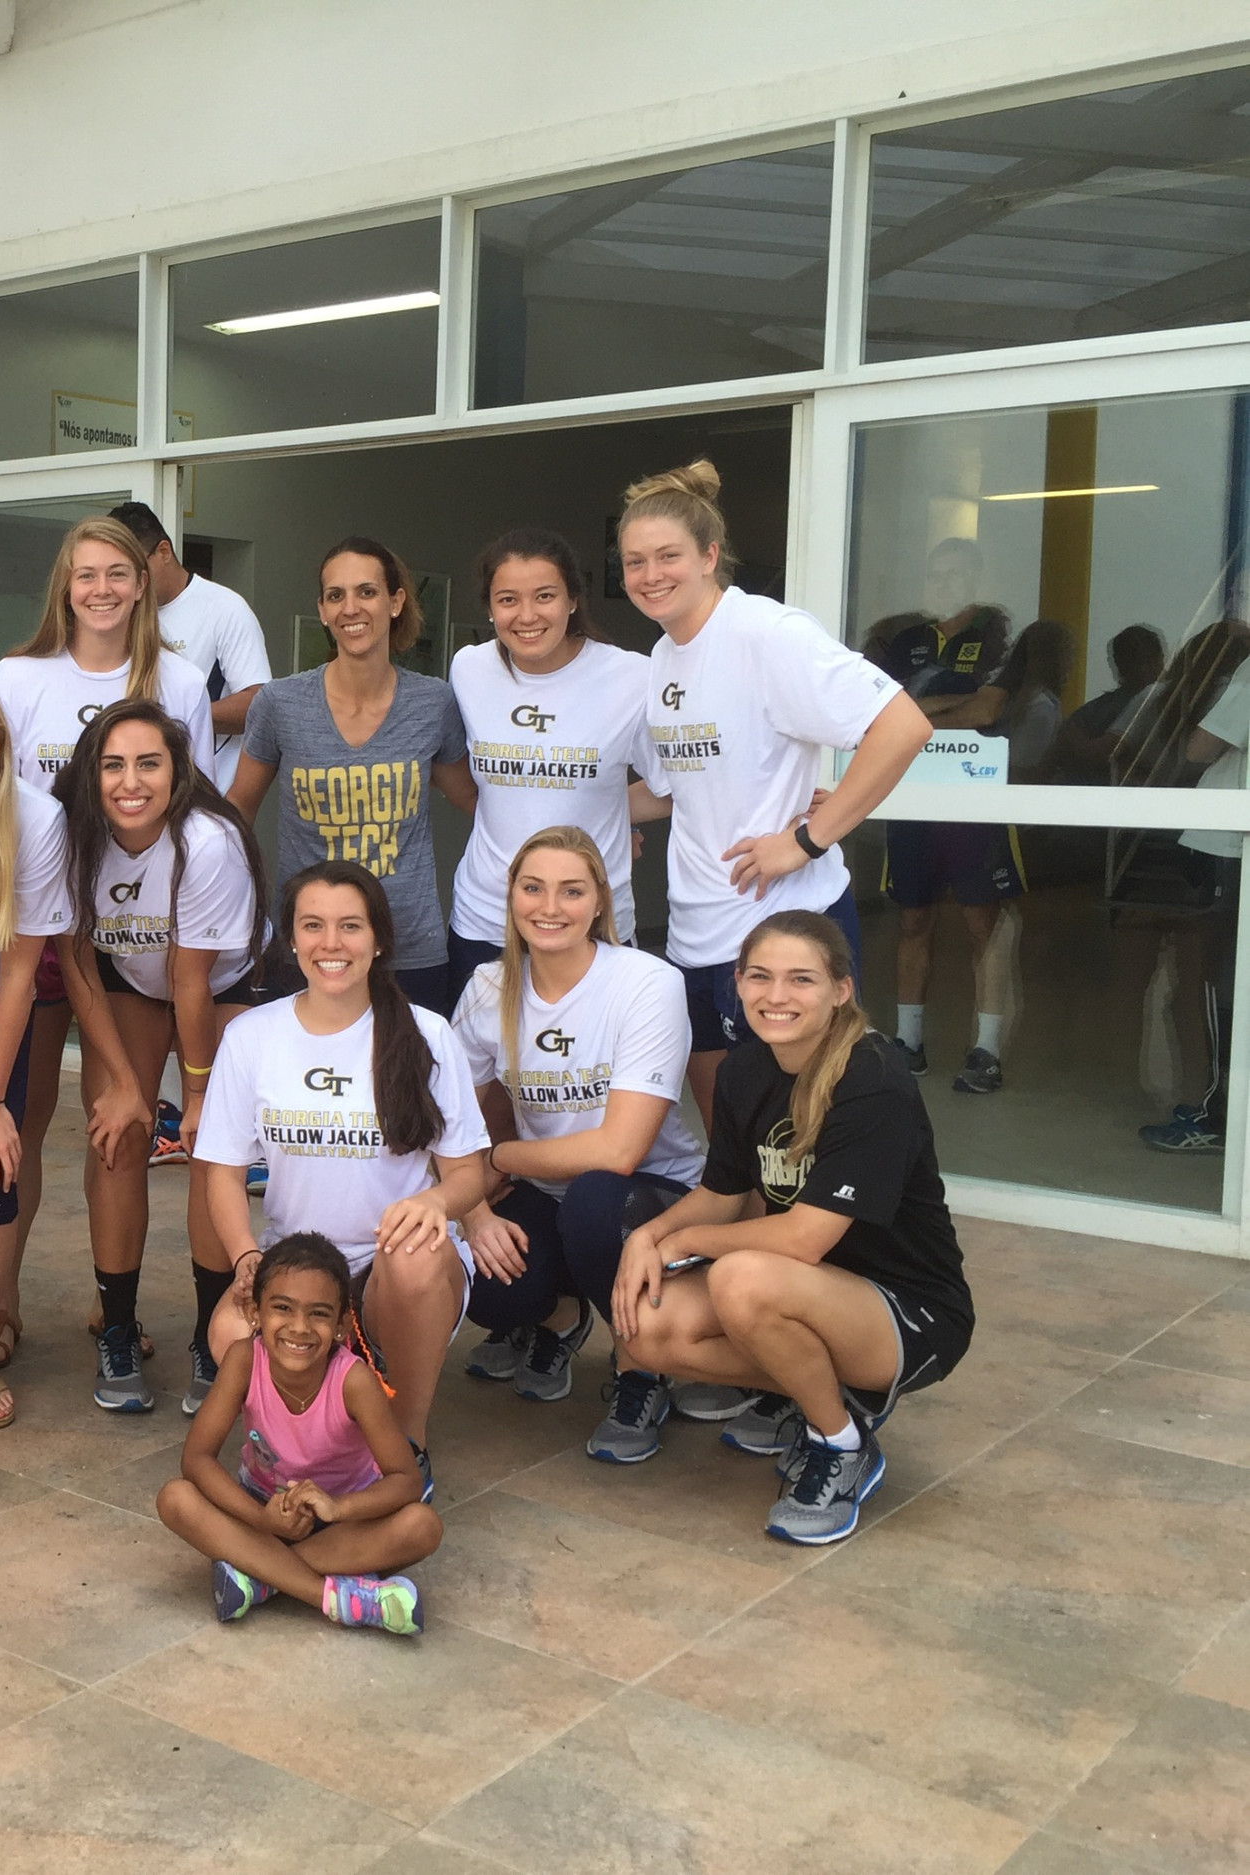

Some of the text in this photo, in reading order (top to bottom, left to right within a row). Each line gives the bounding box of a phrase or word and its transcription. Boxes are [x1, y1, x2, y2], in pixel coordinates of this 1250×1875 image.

[83, 427, 132, 447] apontamos
[661, 682, 686, 711] GT
[511, 704, 556, 733] GT
[37, 743, 78, 759] GEO
[472, 740, 545, 762] GEORGIA
[672, 740, 720, 759] JACKETS
[920, 742, 980, 754] CHADO
[472, 756, 598, 779] YELLOW JACKETS
[979, 766, 998, 775] CBV
[291, 759, 422, 826] GEORGIA
[318, 822, 400, 878] TECH
[535, 1028, 576, 1058] GT
[304, 1066, 353, 1097] GT
[262, 1108, 345, 1128] GEORGIA
[263, 1125, 324, 1144] YELLOW
[279, 1144, 379, 1160] VOLLEYBALL
